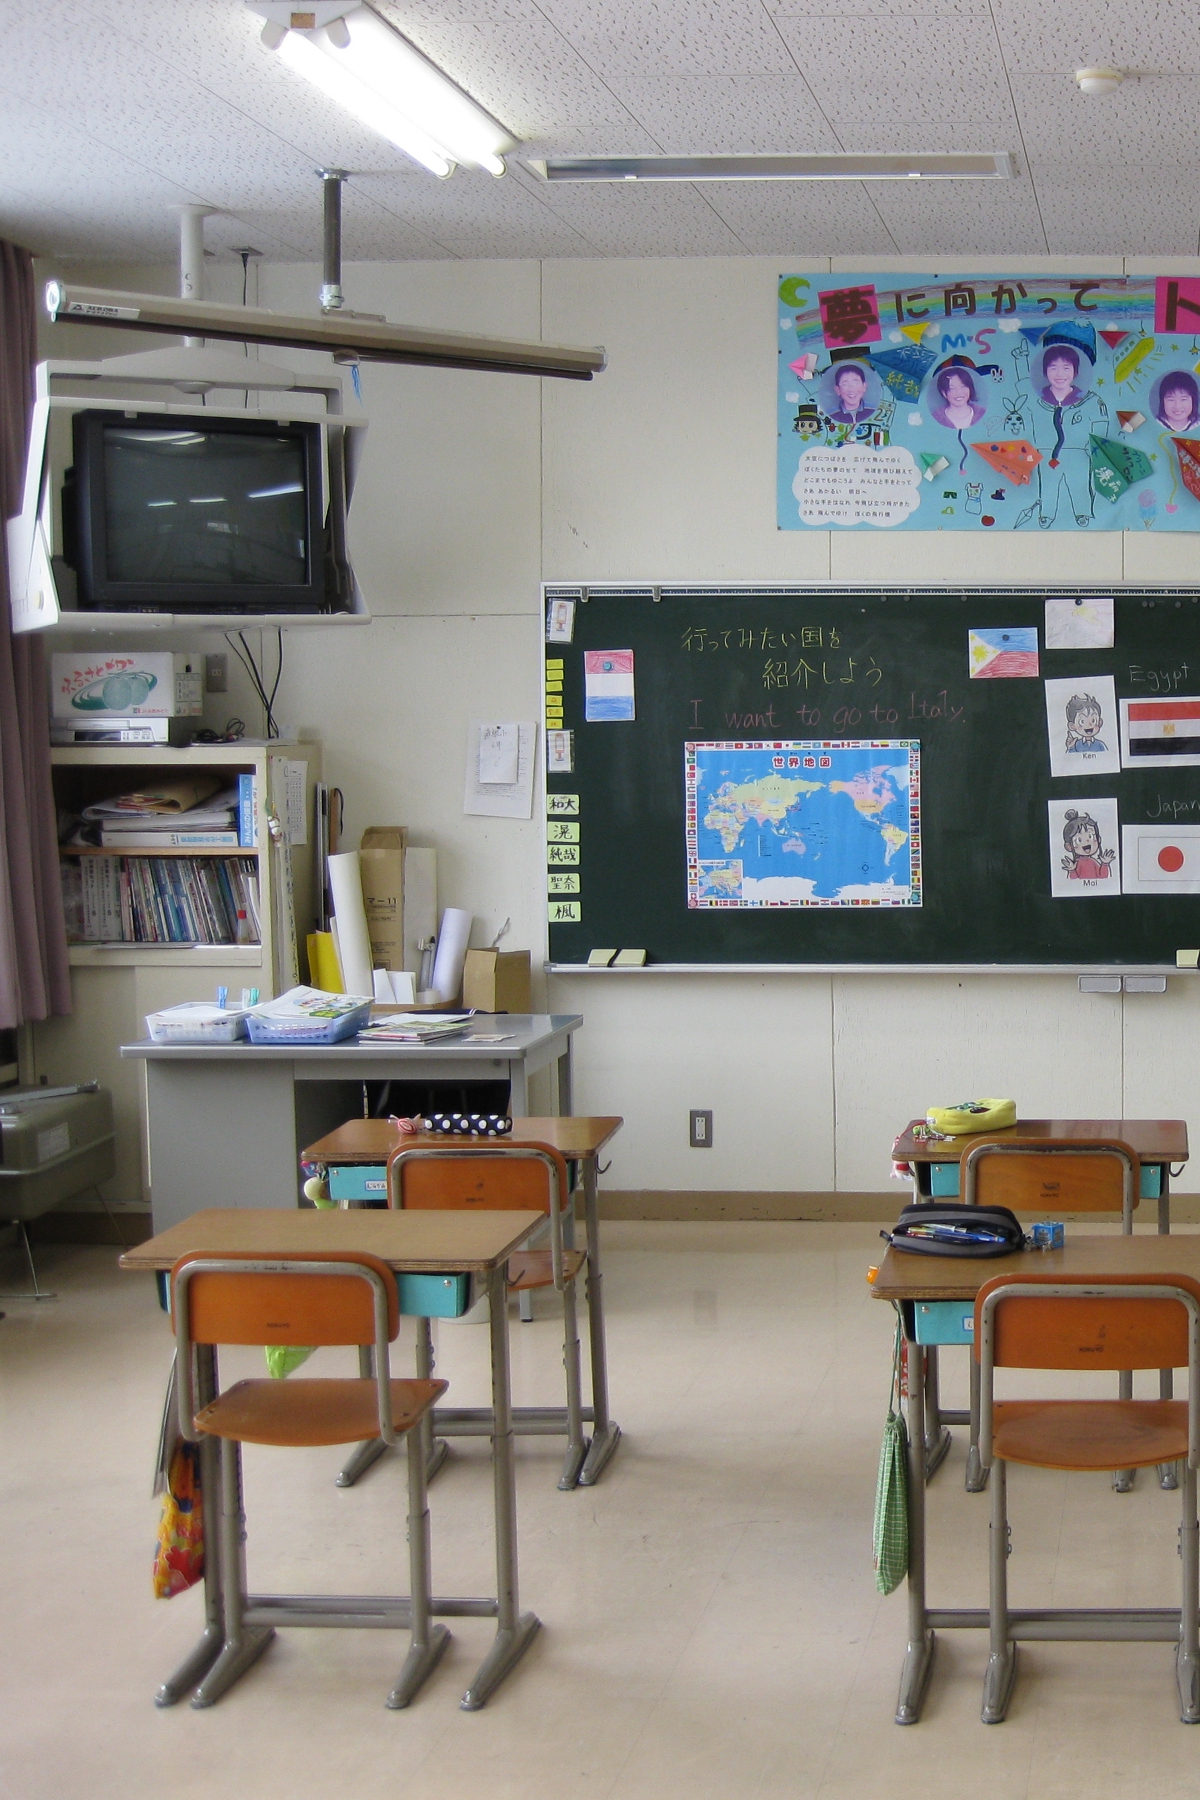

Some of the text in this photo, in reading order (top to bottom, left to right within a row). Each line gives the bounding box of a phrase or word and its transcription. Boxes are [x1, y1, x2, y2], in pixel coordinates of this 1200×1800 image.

[821, 283, 1100, 343] 夢に向かって
[681, 626, 841, 651] 行ってみたい国を
[762, 657, 882, 689] 紹介しよう
[1129, 662, 1189, 692] Egypt
[689, 700, 704, 730] I
[725, 704, 781, 729] want
[796, 704, 820, 726] to
[833, 707, 861, 733] go
[870, 704, 898, 726] to
[773, 756, 832, 769] 世界地図
[1147, 794, 1200, 819] Japan
